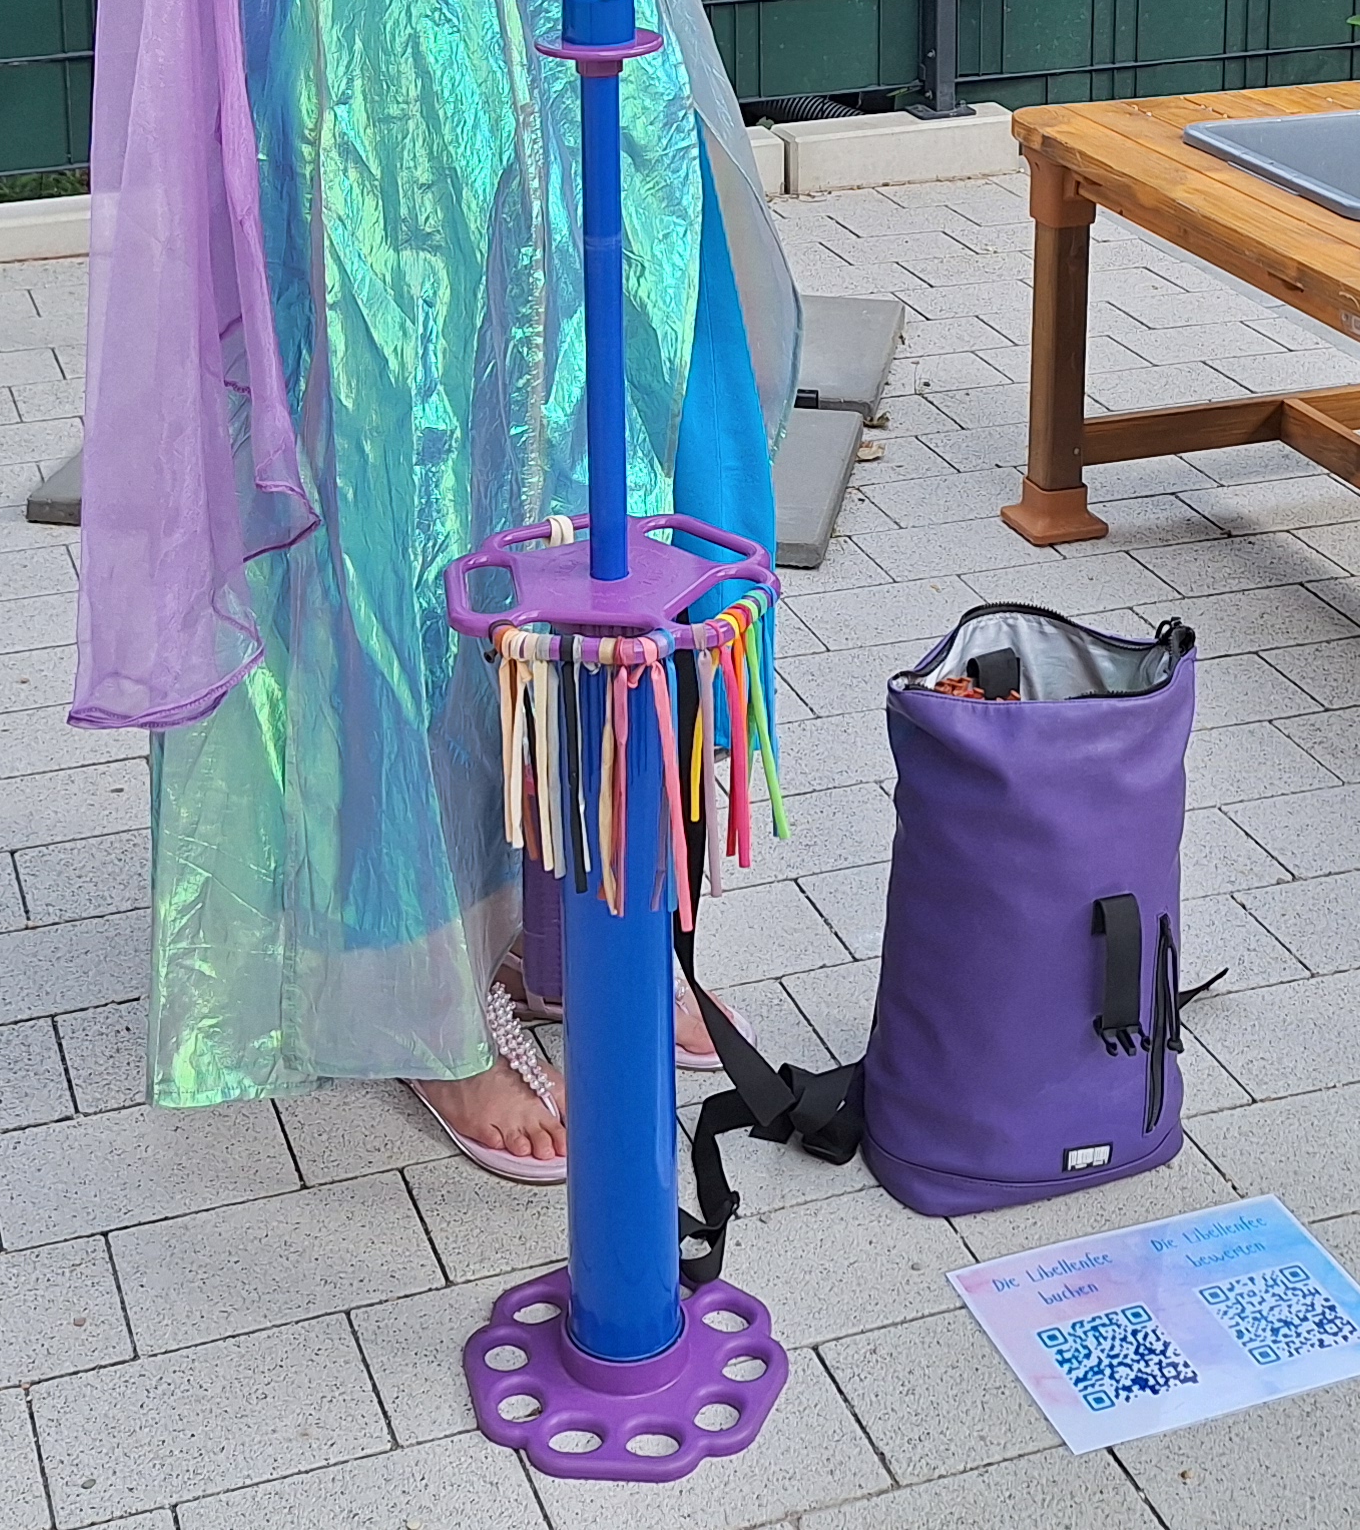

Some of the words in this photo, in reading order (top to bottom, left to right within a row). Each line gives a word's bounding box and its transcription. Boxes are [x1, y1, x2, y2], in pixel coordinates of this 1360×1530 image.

[1151, 1238, 1179, 1252] Die
[1182, 1214, 1267, 1244] Libellenfee
[1185, 1242, 1267, 1268] bewerten
[991, 1276, 1020, 1293] Die
[1025, 1252, 1113, 1283] Libellenfee
[1037, 1283, 1099, 1306] buchen
